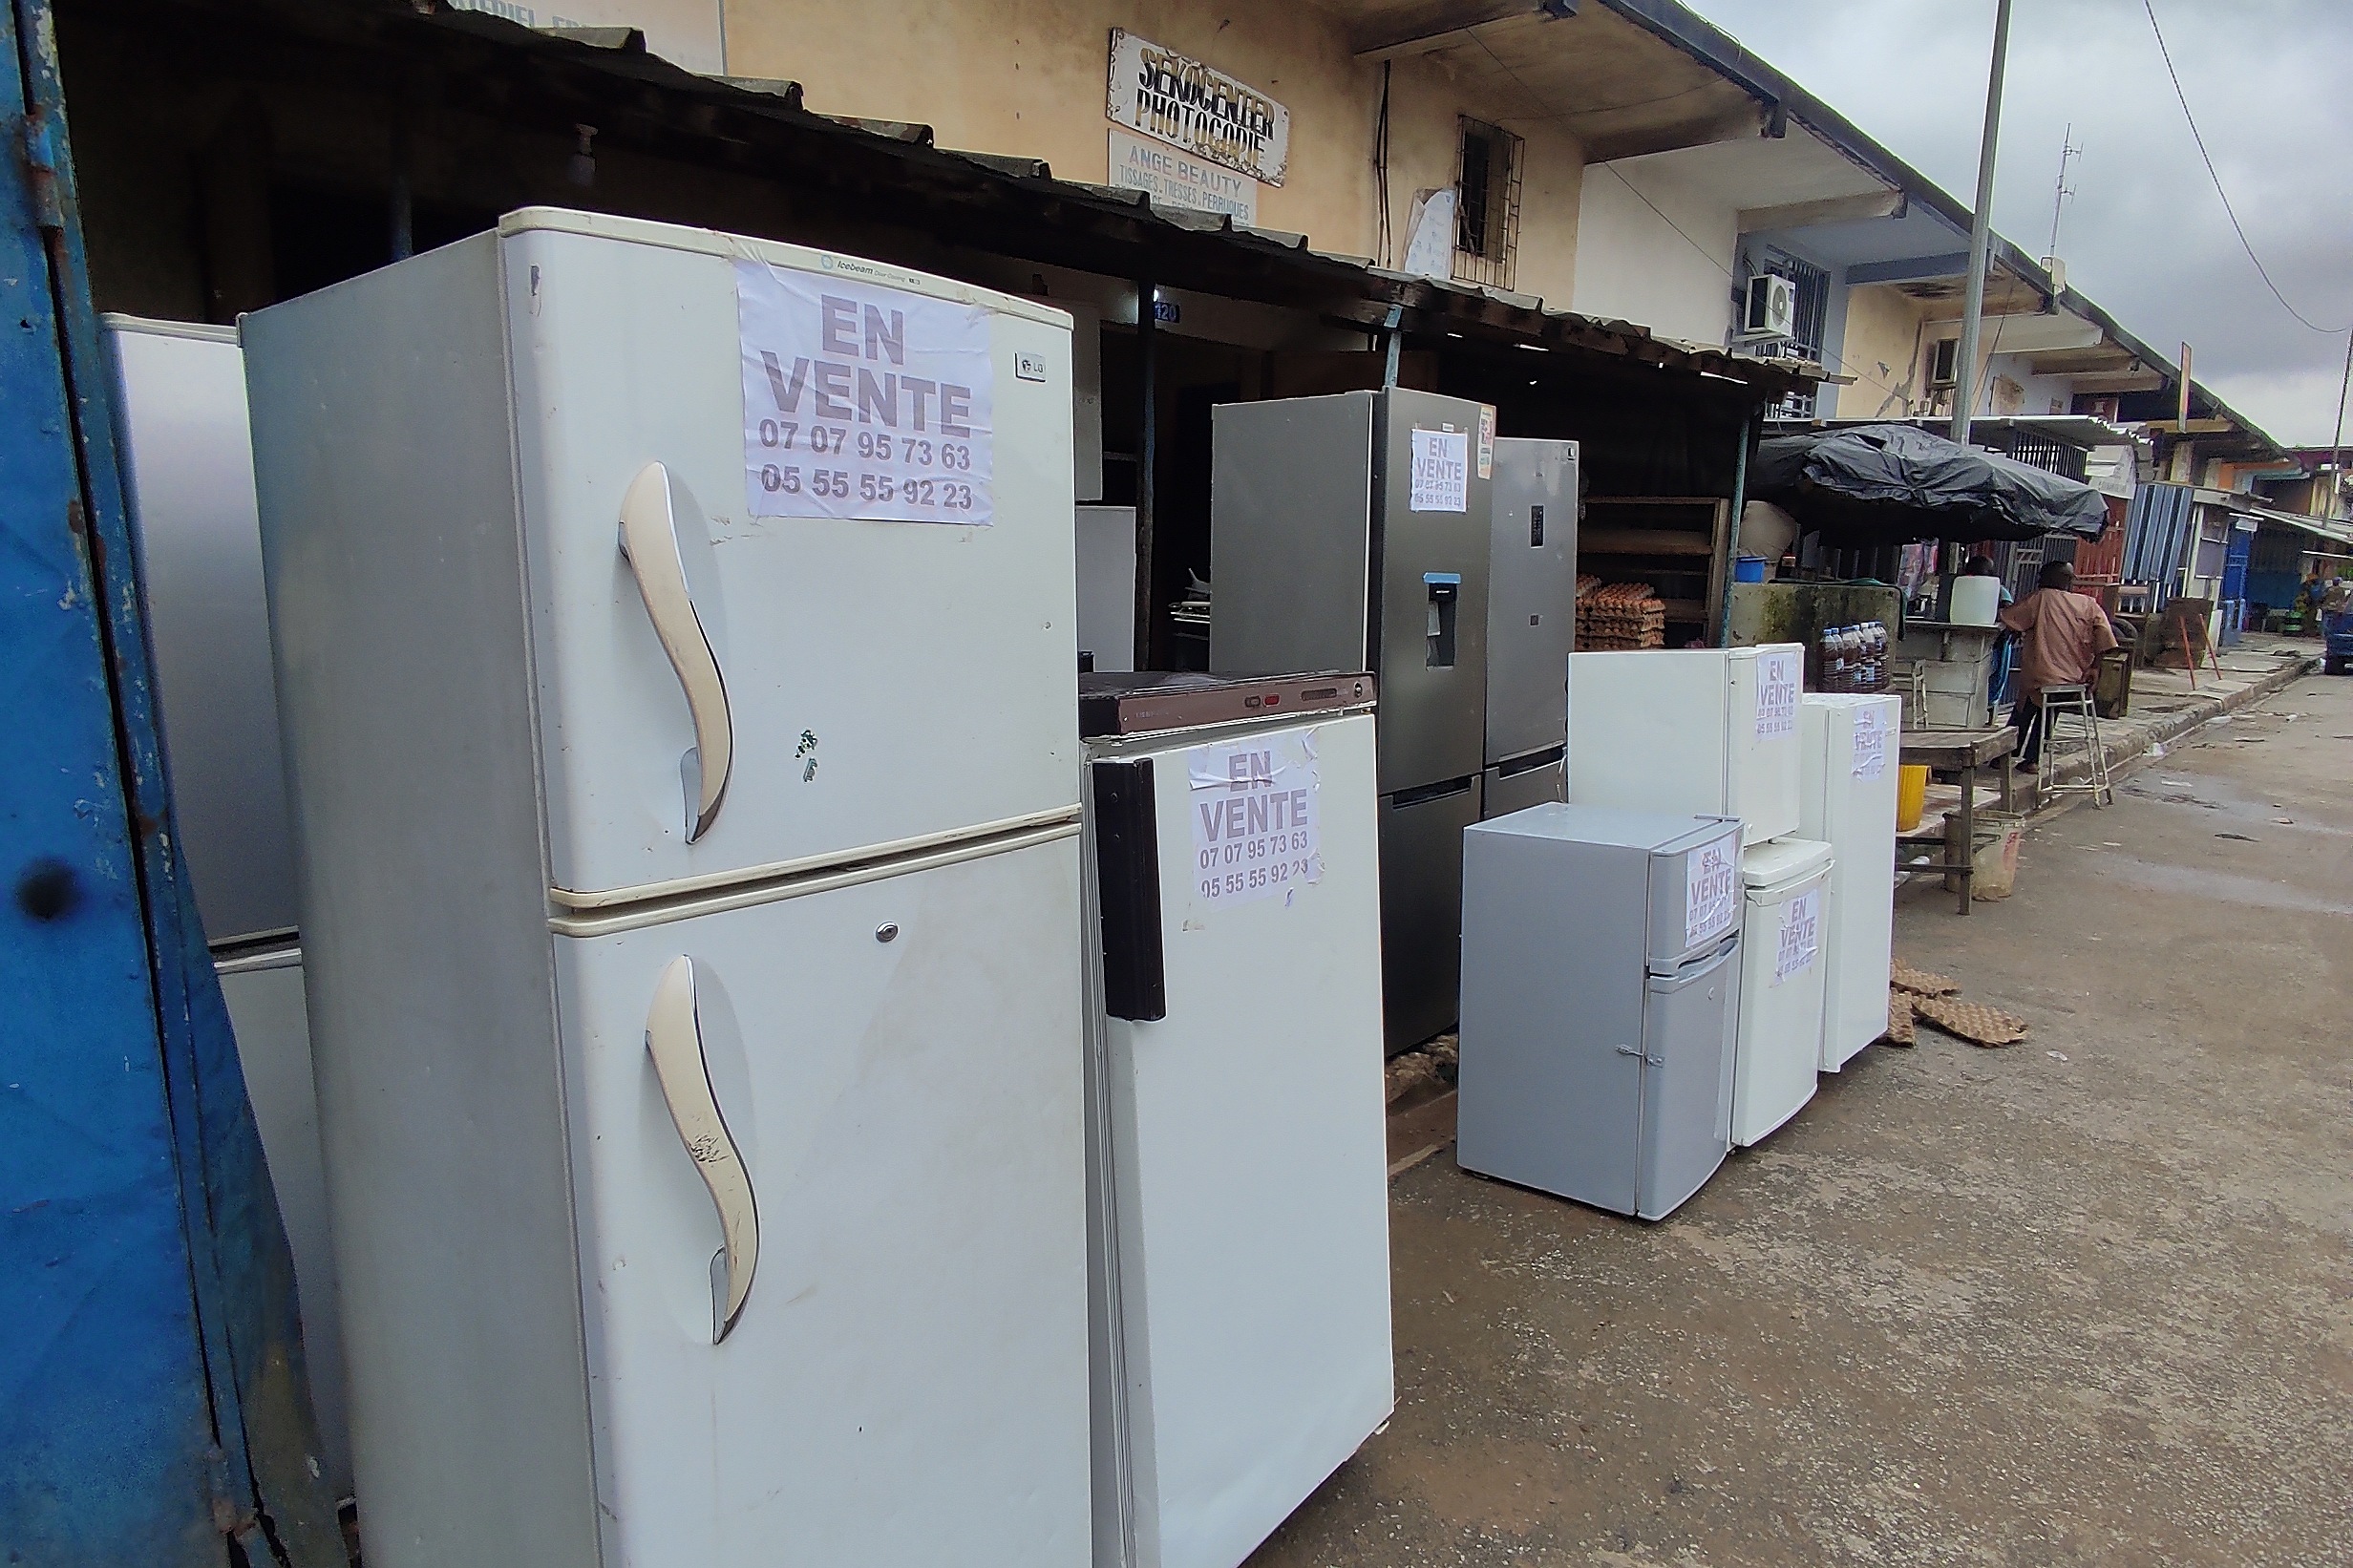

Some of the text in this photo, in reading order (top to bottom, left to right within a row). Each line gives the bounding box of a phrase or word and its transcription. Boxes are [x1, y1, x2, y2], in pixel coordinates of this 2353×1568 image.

[1135, 88, 1266, 168] PHOTOCOPIE
[1129, 146, 1241, 198] ANGE BEAUTY
[1120, 164, 1249, 222] TISSAGES TRESSES PERRUQUES
[837, 261, 874, 275] Icebeam
[821, 294, 903, 365] EN
[760, 350, 971, 438] VENTE
[759, 418, 970, 471] 07 07 95 73 63
[1429, 437, 1448, 457] EN
[761, 463, 972, 510] 05 55 55 92 23
[1417, 457, 1462, 480] VENTE
[1770, 660, 1784, 681] EN
[1761, 683, 1794, 706] VENTE
[1228, 751, 1273, 793] EN
[1199, 789, 1308, 842] VENTE
[1199, 830, 1308, 870] 07 07 95 73 63
[1201, 877, 1220, 899] 05
[1226, 872, 1244, 895] 55
[1249, 867, 1266, 889] 55
[1271, 862, 1287, 883] 92
[1691, 868, 1731, 905] VENTE
[1791, 898, 1807, 922] EN
[1780, 916, 1815, 947] VENTE
